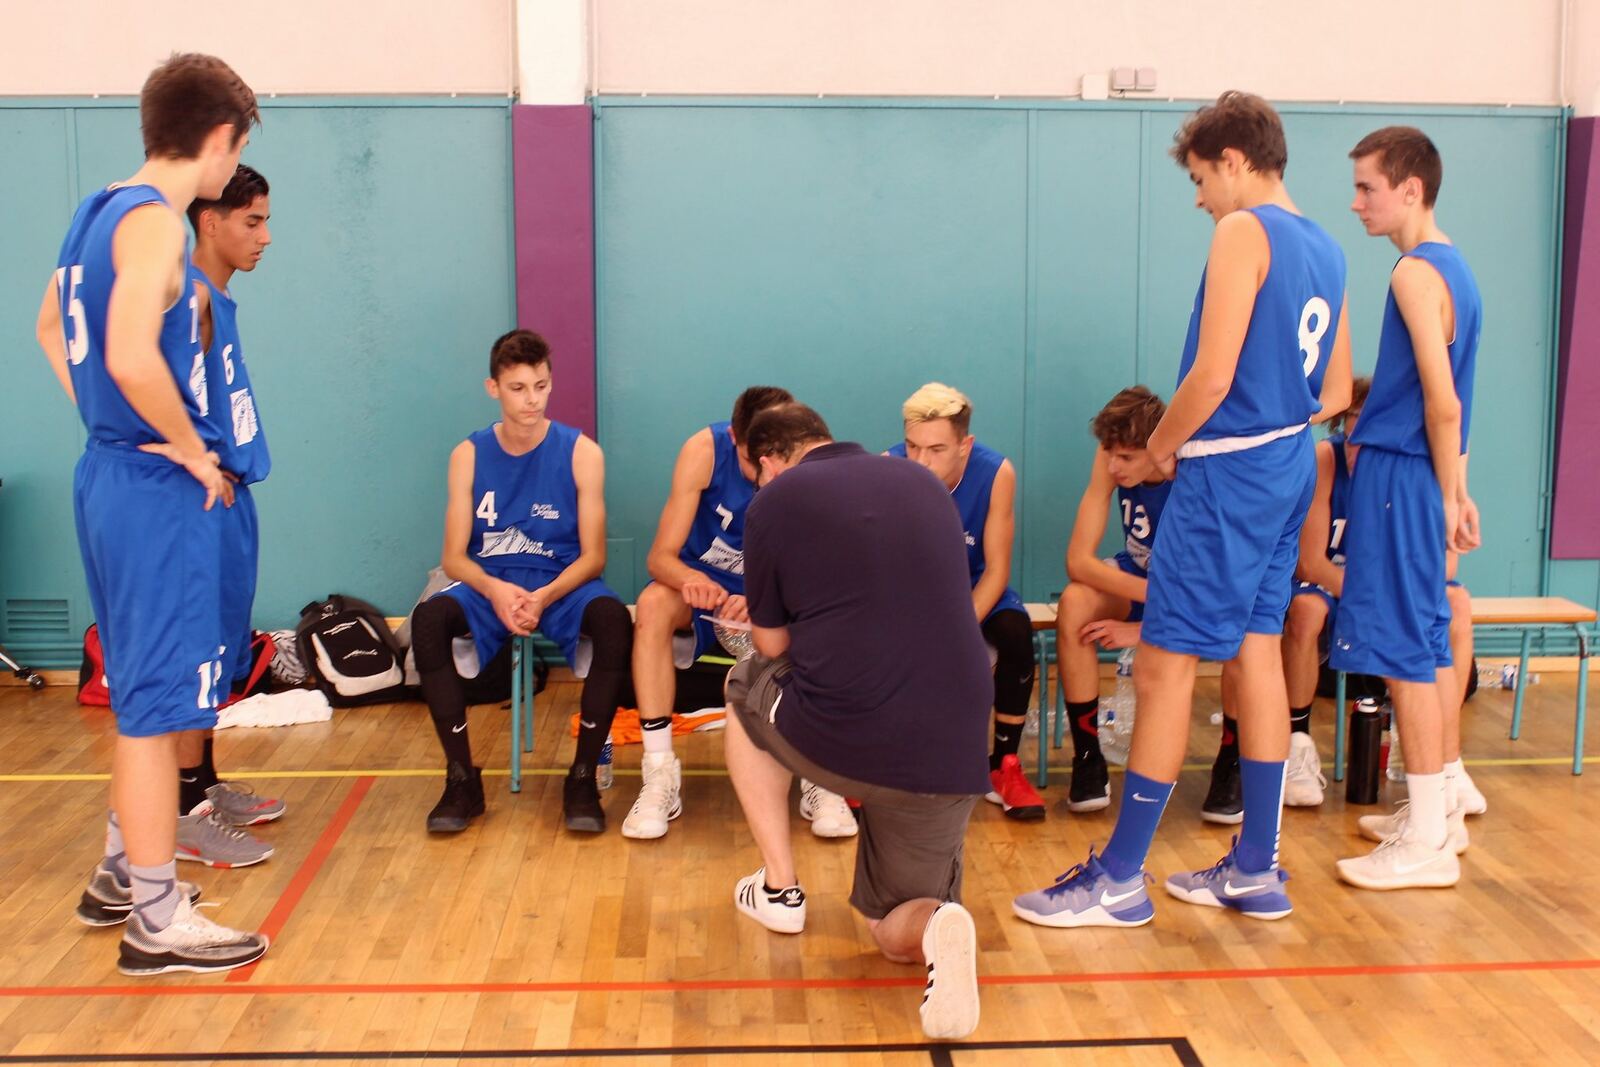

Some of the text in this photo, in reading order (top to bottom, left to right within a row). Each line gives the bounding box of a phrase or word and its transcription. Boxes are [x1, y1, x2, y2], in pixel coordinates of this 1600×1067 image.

[1298, 296, 1331, 378] 8
[222, 344, 235, 386] 6
[476, 491, 498, 527] 4
[1121, 499, 1151, 539] 13
